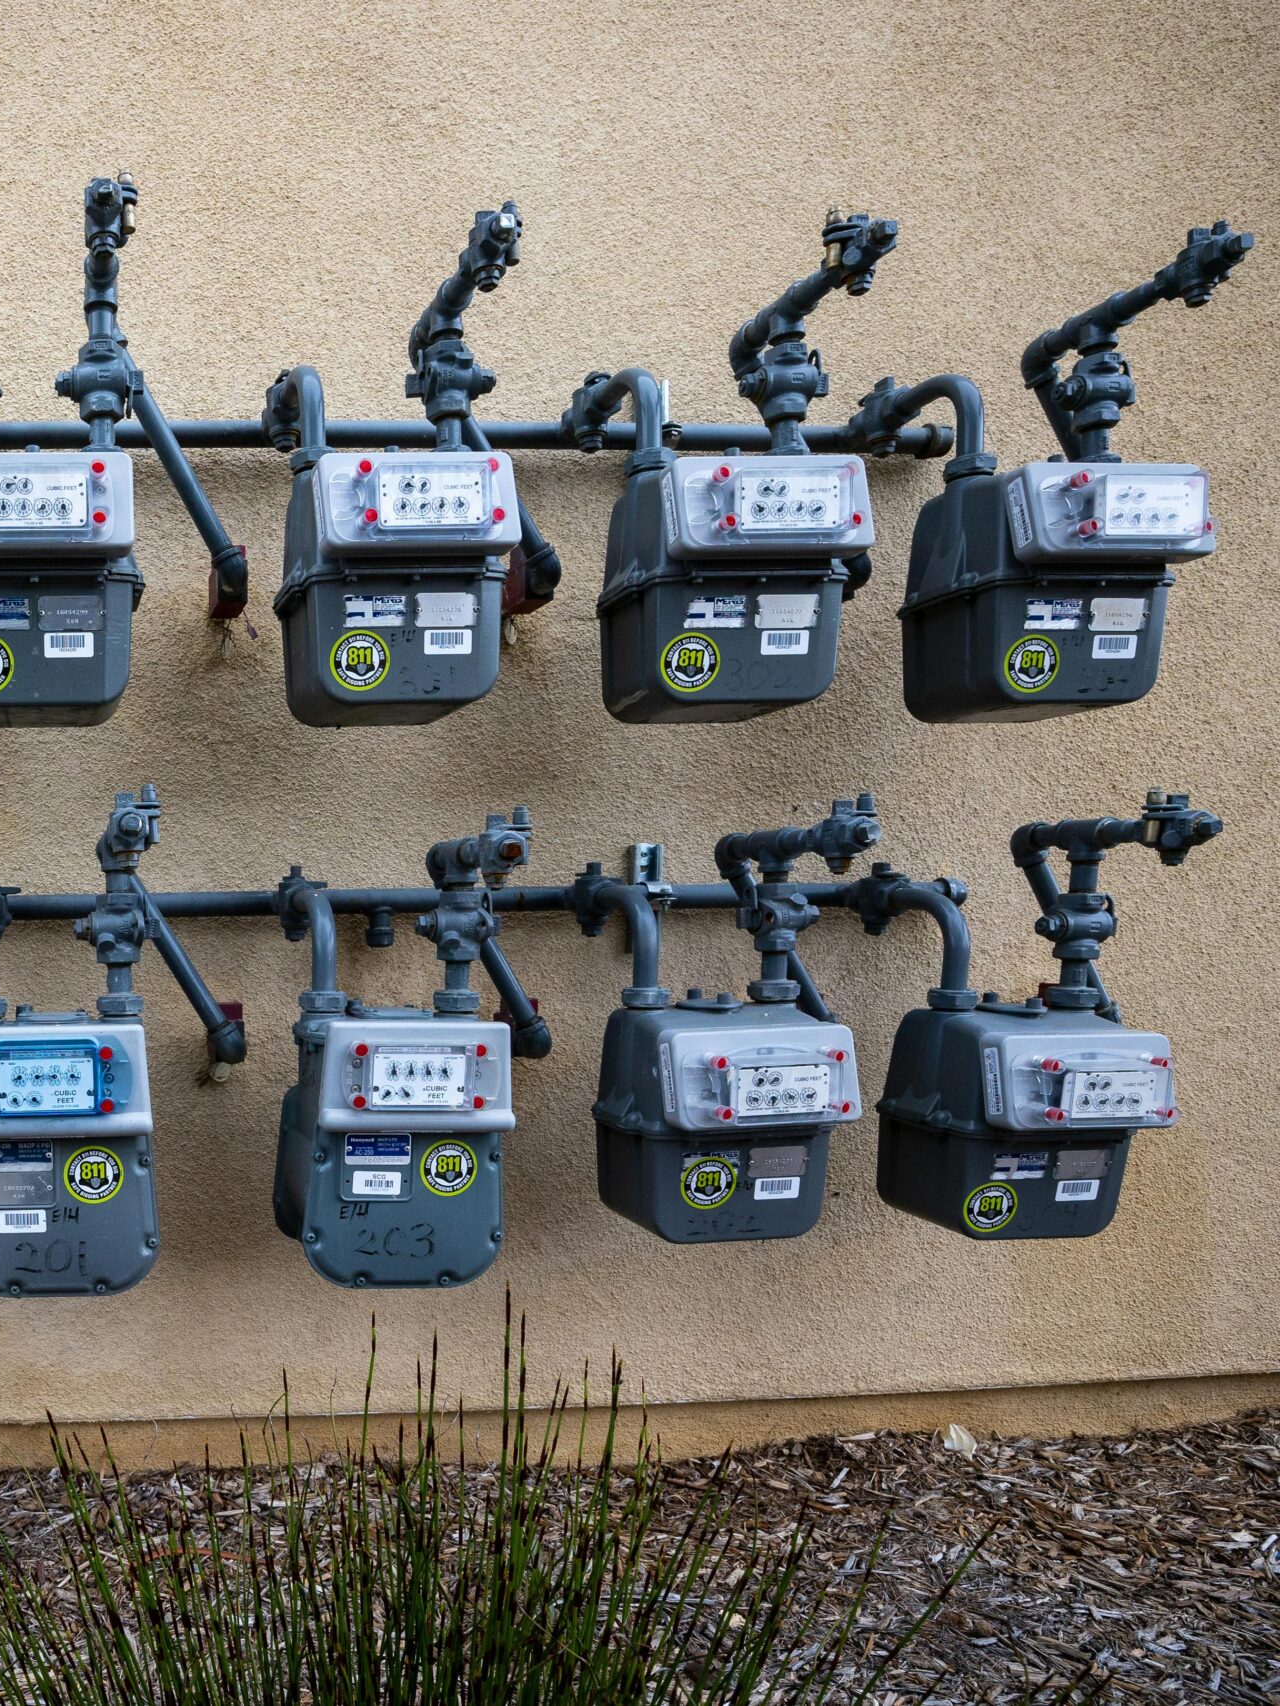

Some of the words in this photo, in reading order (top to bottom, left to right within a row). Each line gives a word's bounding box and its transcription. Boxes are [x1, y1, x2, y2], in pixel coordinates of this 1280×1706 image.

[335, 639, 348, 661] CONTACT
[356, 634, 375, 643] BEFORE
[347, 646, 372, 665] 811
[678, 648, 704, 667] 811
[1020, 650, 1044, 668] 811
[69, 1155, 81, 1175] CONTACT
[89, 1150, 108, 1158] BEFORE
[81, 1161, 105, 1179] 811
[436, 1155, 460, 1172] 811
[696, 1171, 720, 1187] 811
[979, 1196, 1003, 1211] 811
[355, 1223, 436, 1257] 203
[15, 1239, 88, 1277] 201
